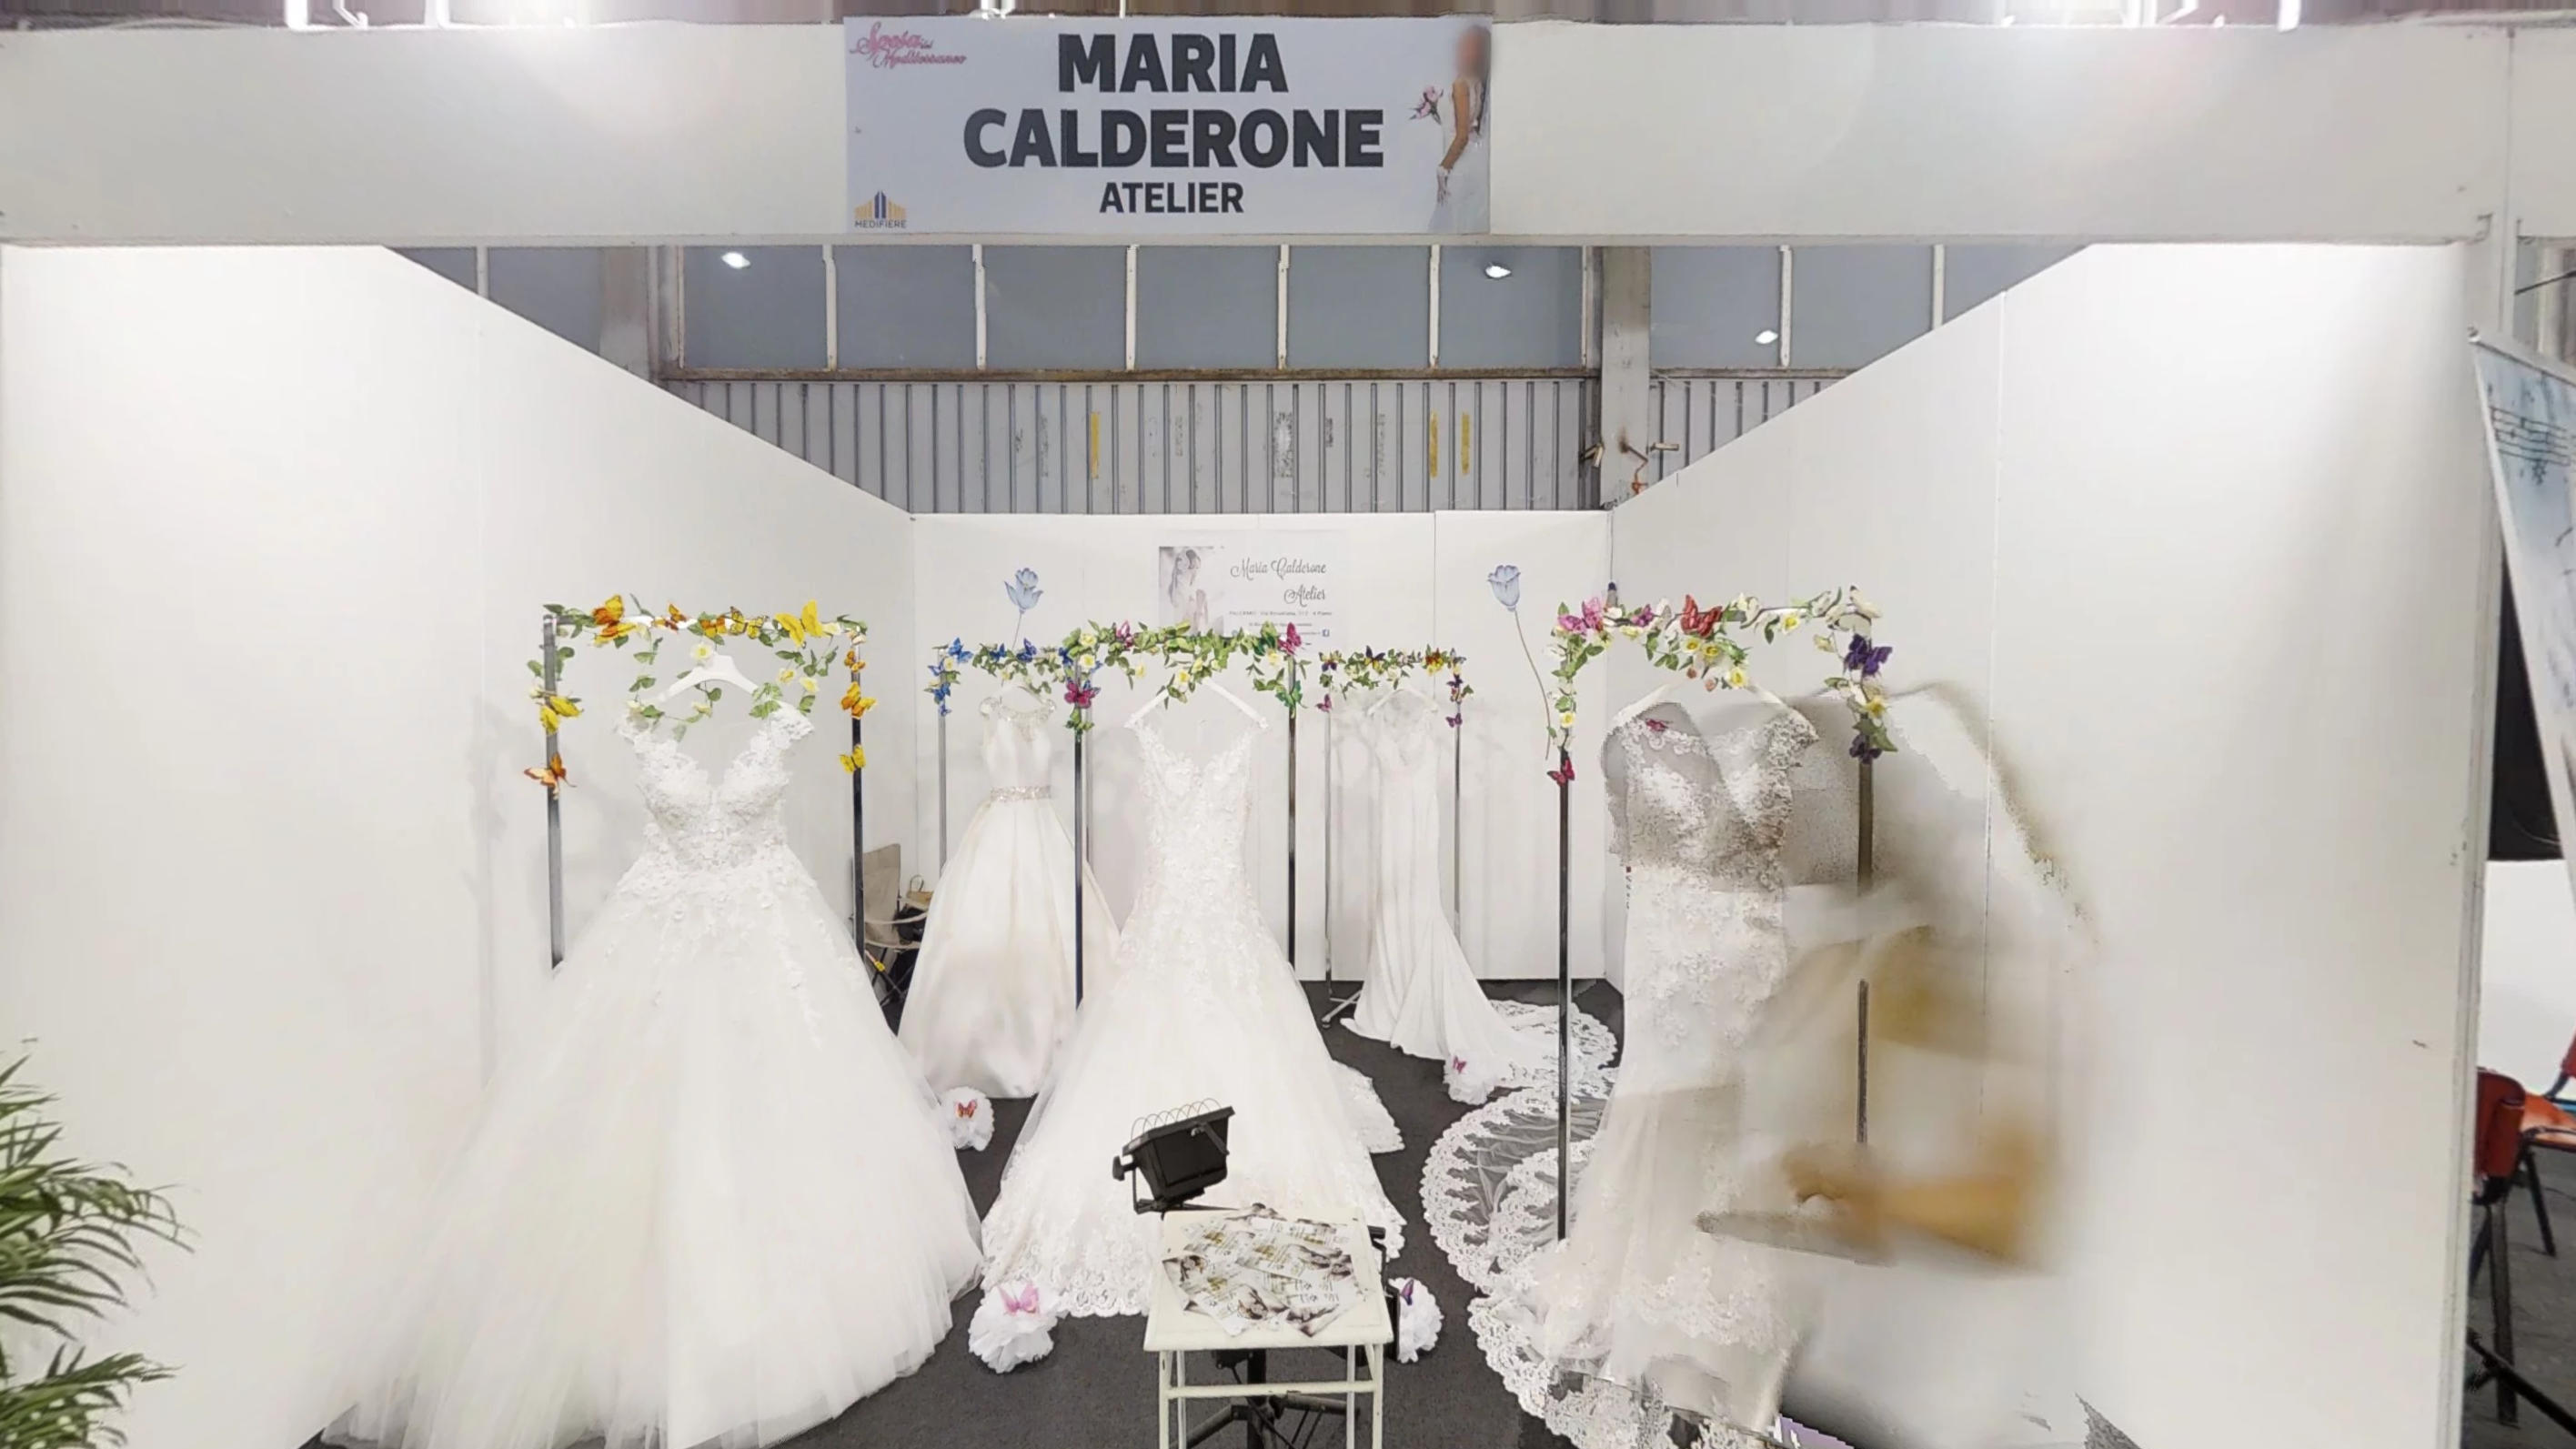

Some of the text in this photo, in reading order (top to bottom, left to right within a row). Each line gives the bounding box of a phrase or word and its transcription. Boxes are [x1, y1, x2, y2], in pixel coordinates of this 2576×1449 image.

[1059, 34, 1288, 92] MARIA
[963, 108, 1384, 167] CALDERONE
[1100, 182, 1244, 214] ATELIER
[854, 219, 908, 229] MEDIFIERE
[1230, 557, 1326, 580] Maria Calderone
[1284, 584, 1326, 607] Atelier
